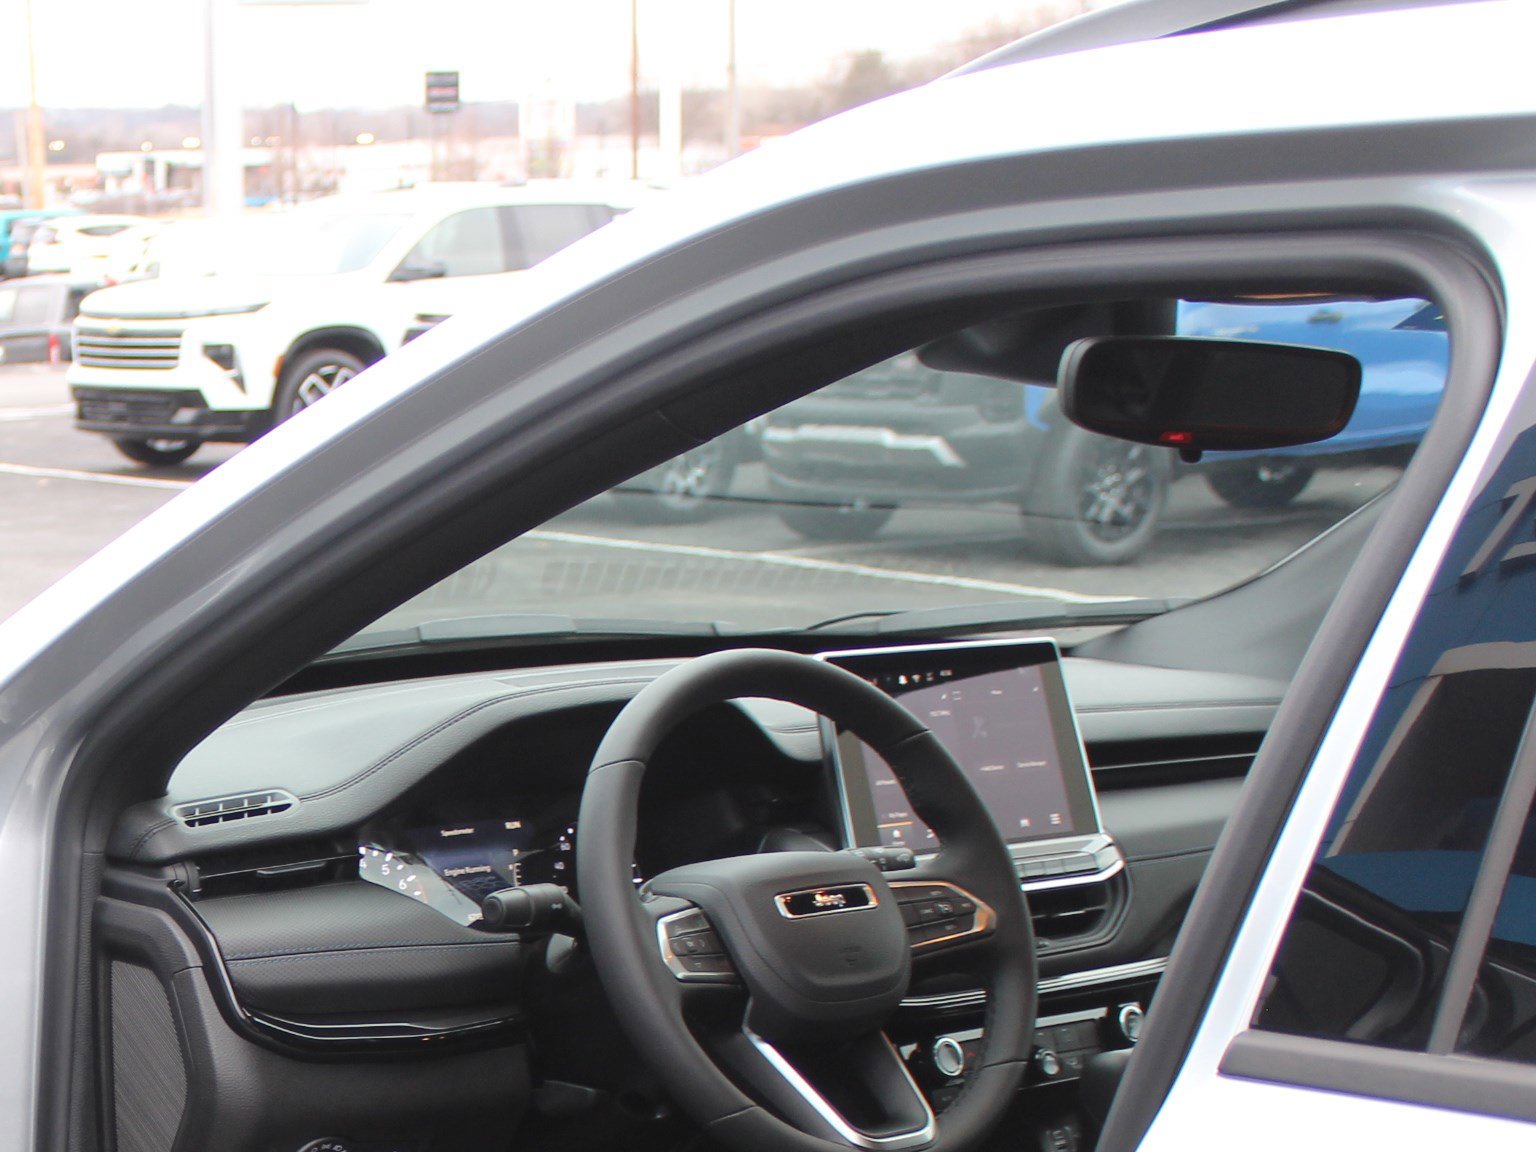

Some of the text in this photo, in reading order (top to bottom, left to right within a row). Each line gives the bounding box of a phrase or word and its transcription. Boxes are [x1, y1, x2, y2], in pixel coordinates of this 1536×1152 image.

[381, 863, 390, 876] 5
[444, 865, 491, 877] Engine Running
[398, 879, 408, 890] 6
